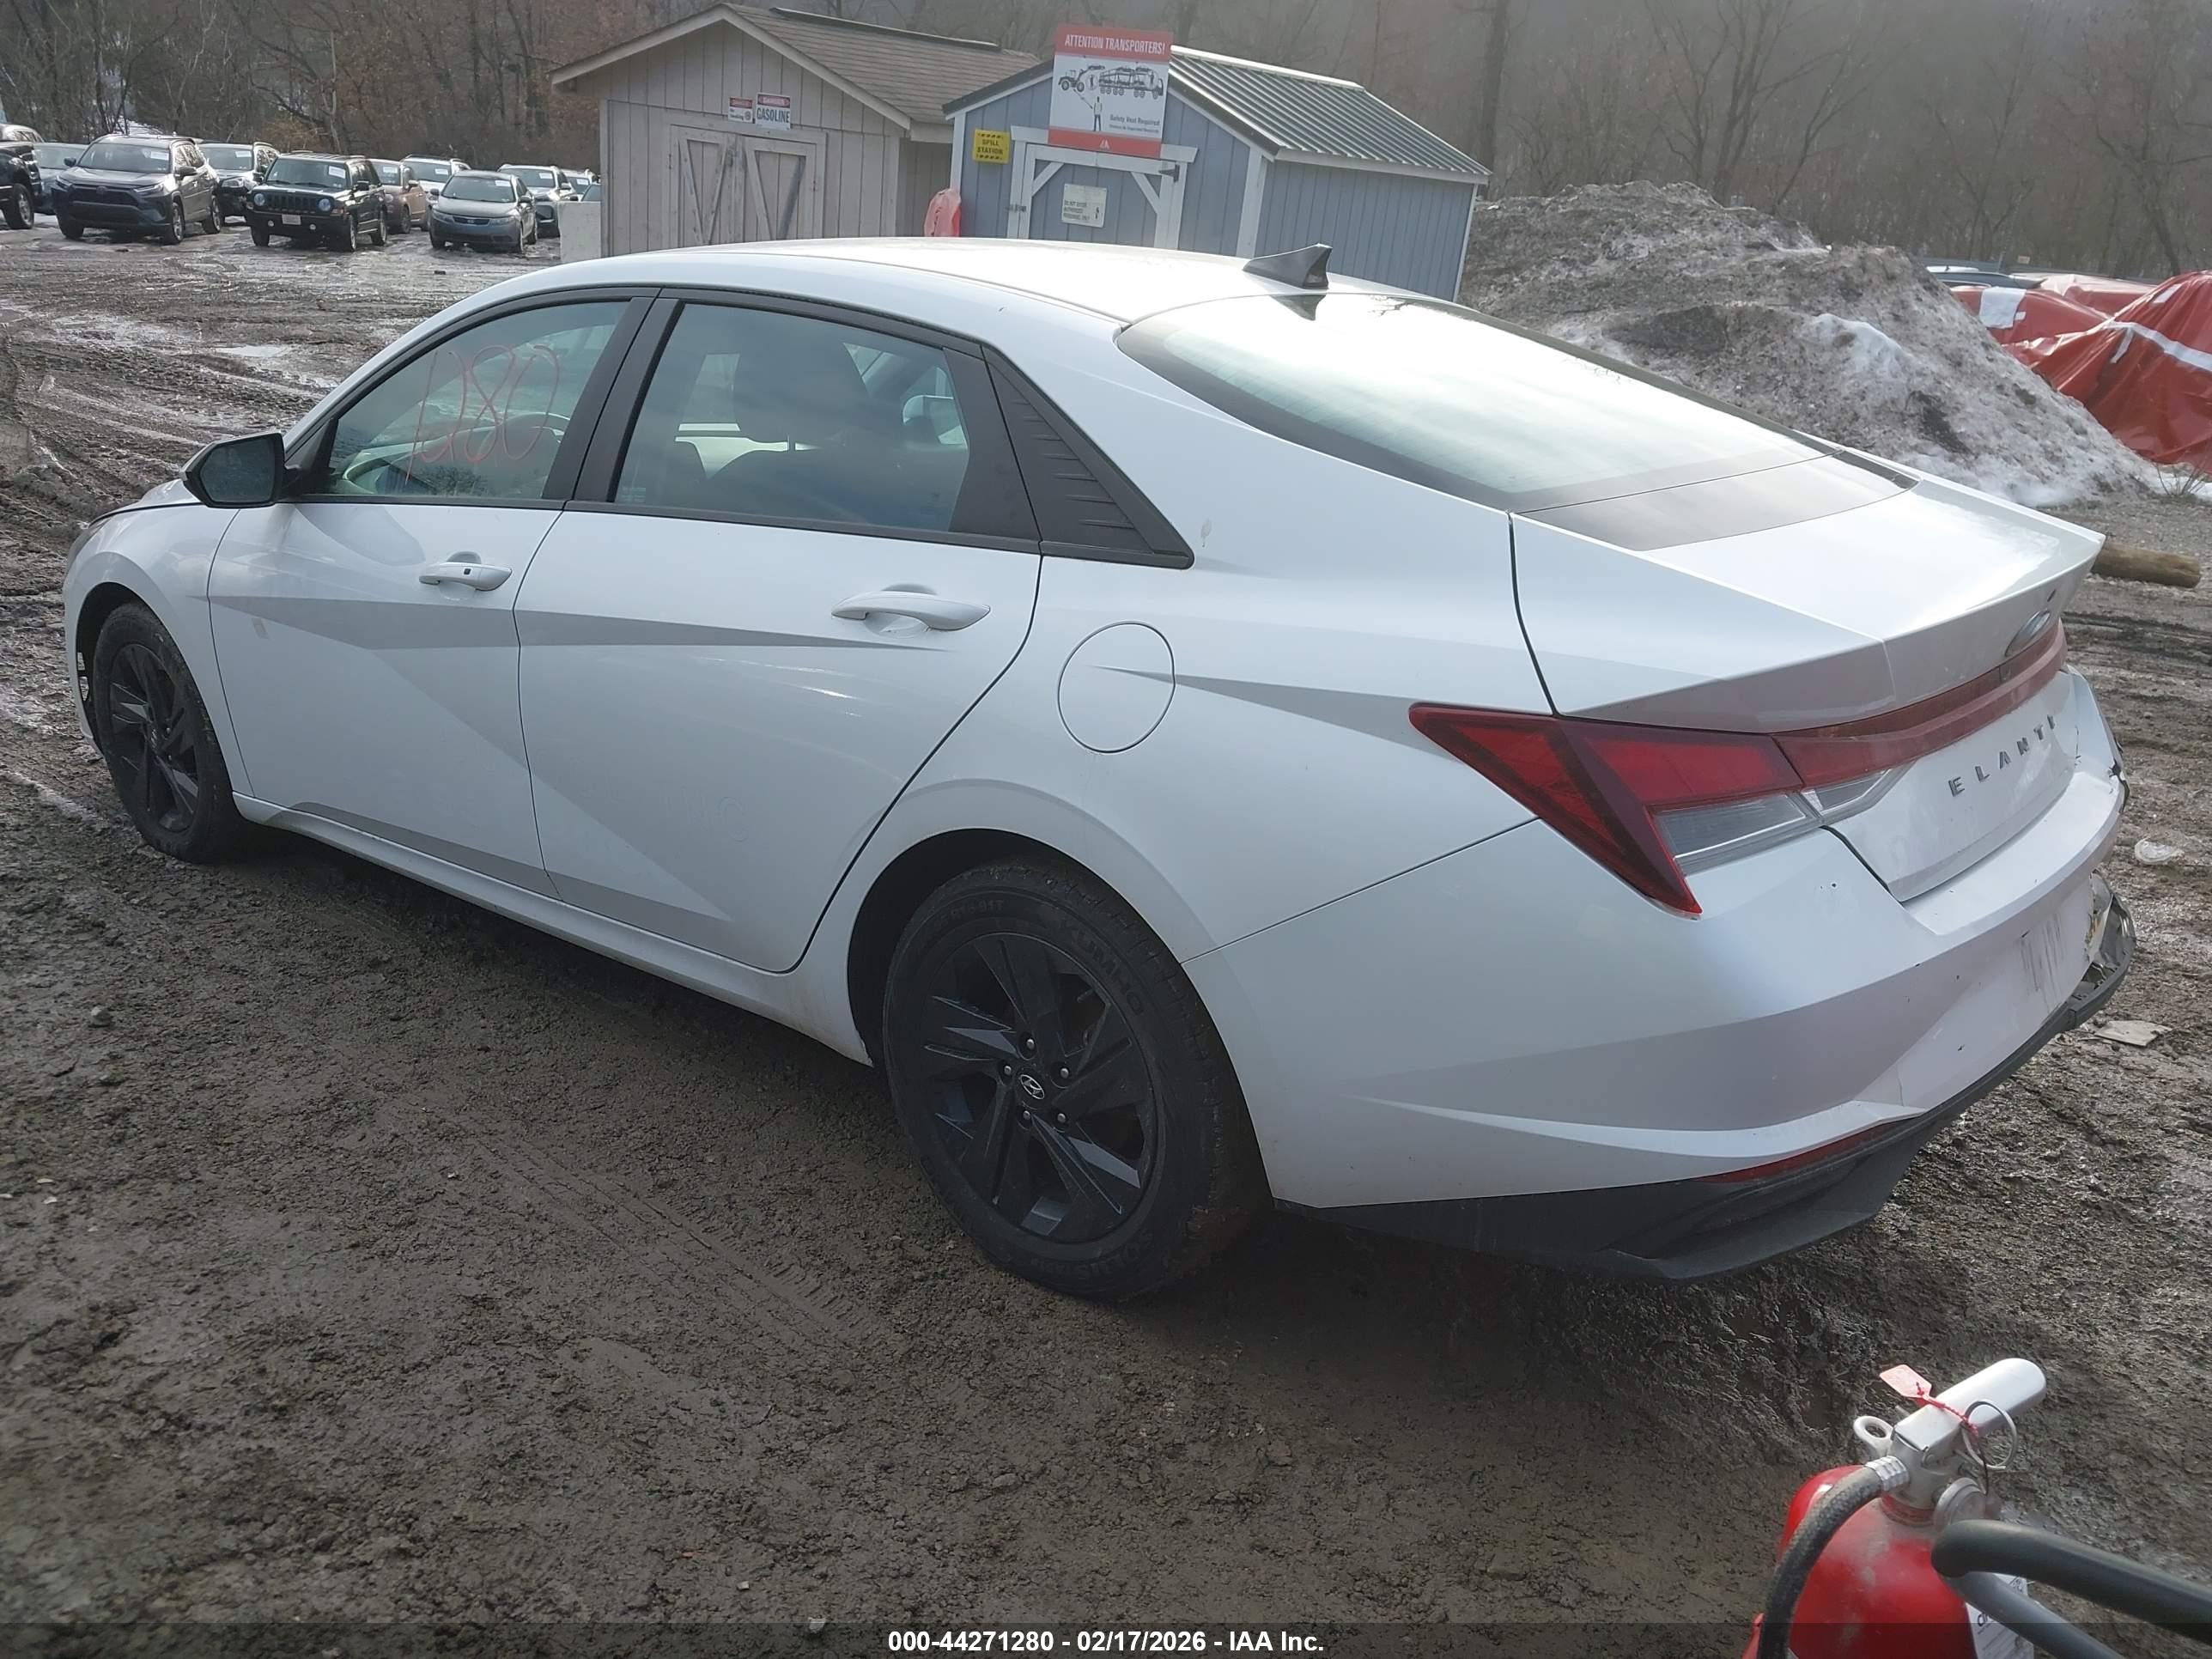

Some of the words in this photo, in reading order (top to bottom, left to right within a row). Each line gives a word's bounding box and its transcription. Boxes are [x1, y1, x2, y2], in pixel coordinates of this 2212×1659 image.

[1065, 34, 1103, 49] ATTENTION
[1105, 37, 1165, 55] TRANSPORTERS!
[757, 107, 790, 123] GASOLINE
[977, 146, 1004, 155] STATION
